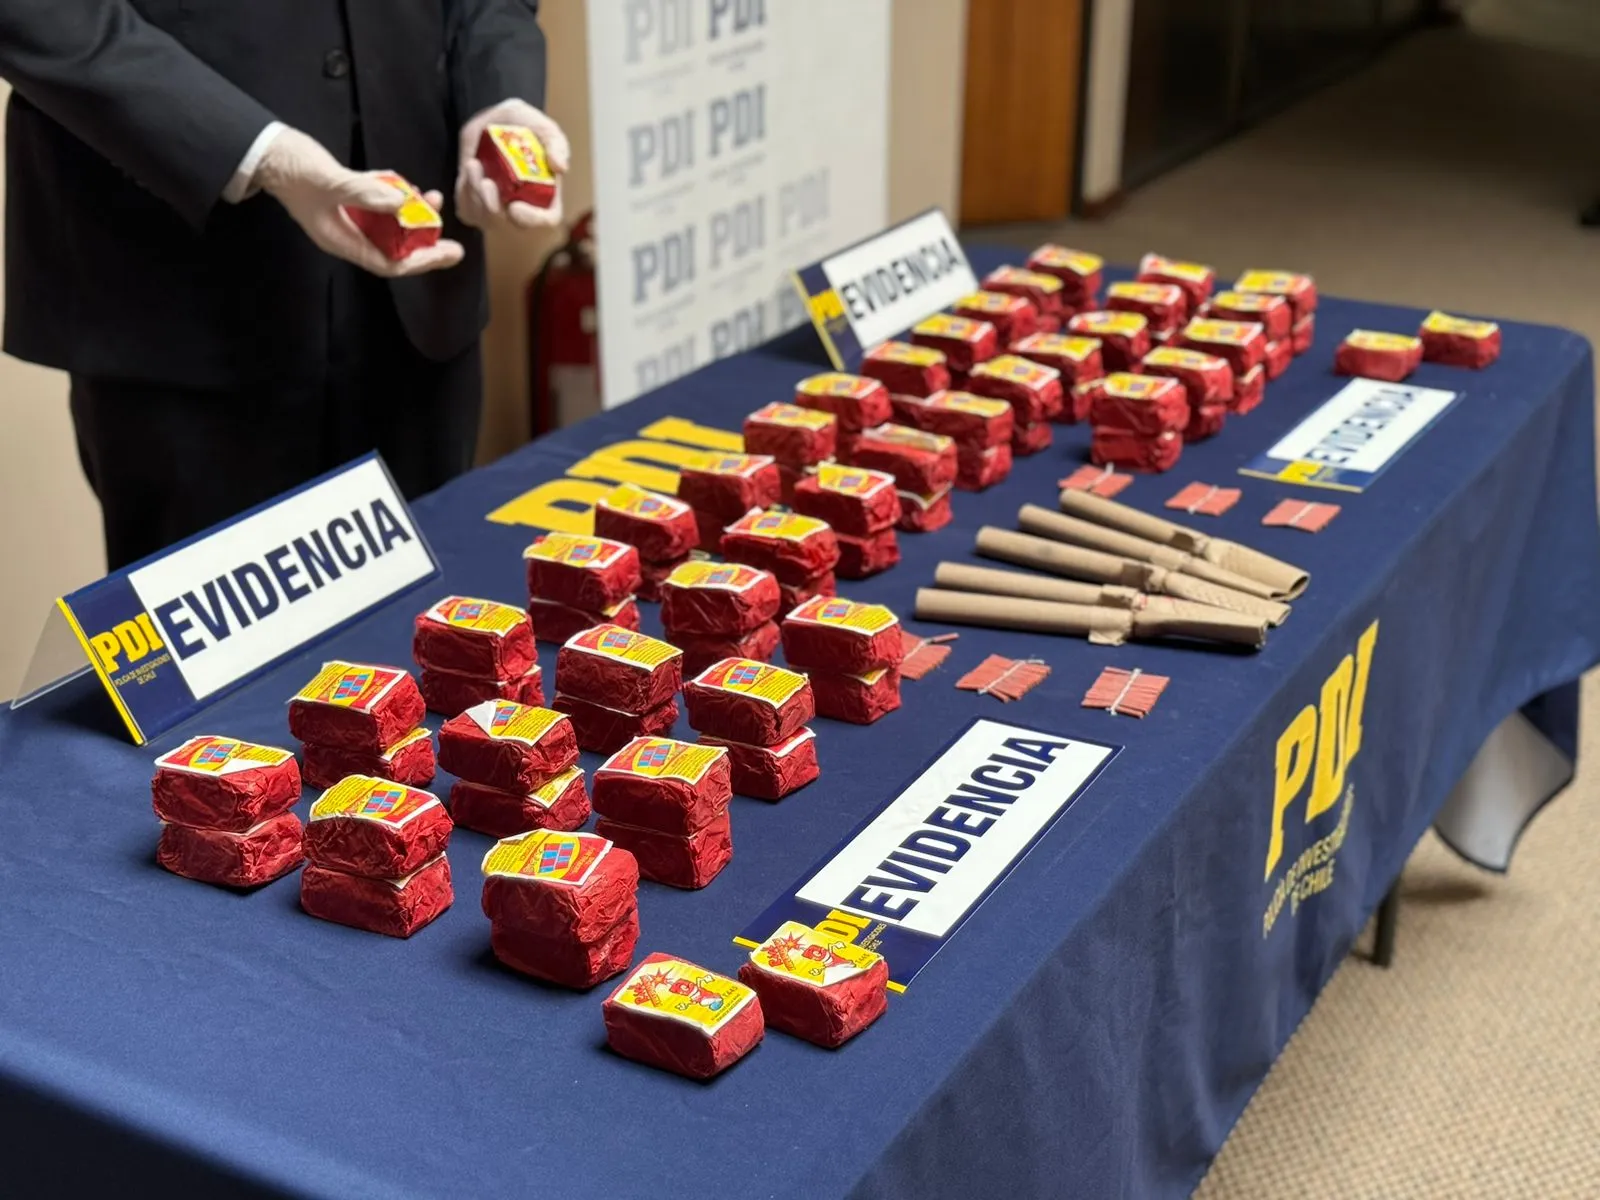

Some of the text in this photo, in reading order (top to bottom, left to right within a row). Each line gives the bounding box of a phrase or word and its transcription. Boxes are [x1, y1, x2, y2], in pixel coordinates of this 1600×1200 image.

[627, 84, 766, 189] PDI PDI
[632, 225, 697, 305] PDI
[709, 196, 766, 270] PDI
[841, 237, 960, 319] EVIDENCIA
[1303, 386, 1418, 463] EVIDENCIA
[153, 497, 412, 661] EVIDENCIA
[89, 611, 164, 673] PDI
[1264, 618, 1379, 884] PDI
[840, 737, 1071, 922] EVIDENCIA
[813, 909, 872, 943] DI
